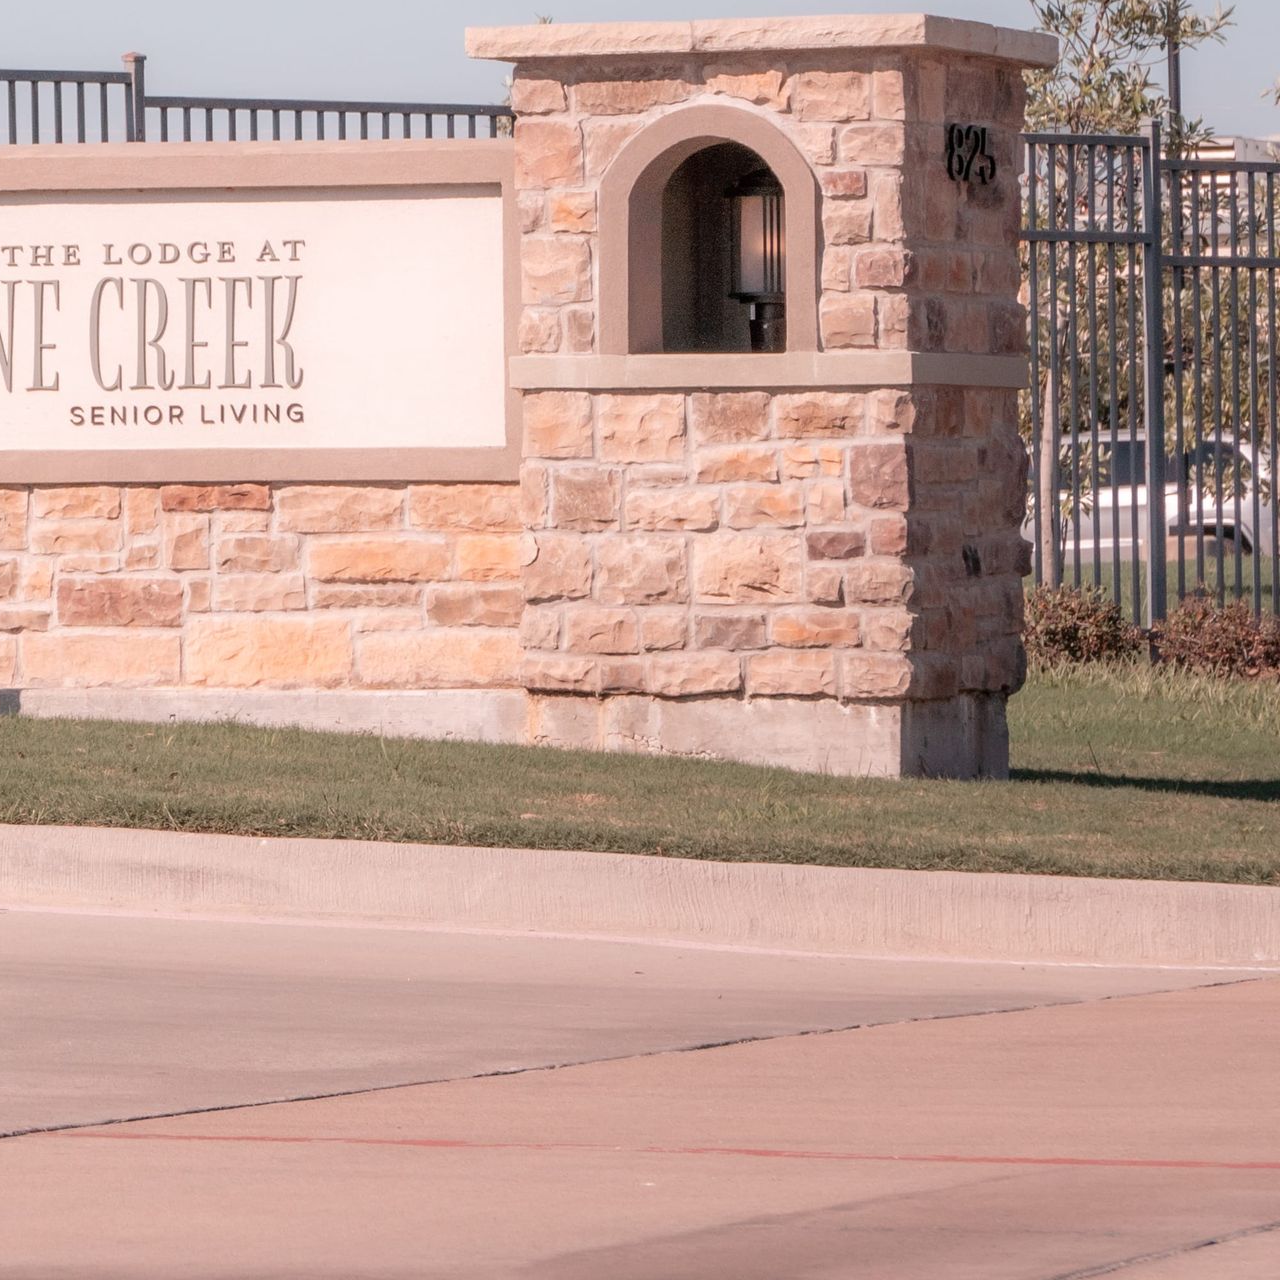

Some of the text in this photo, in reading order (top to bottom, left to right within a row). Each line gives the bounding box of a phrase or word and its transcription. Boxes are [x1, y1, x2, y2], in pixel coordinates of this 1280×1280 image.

[947, 123, 996, 185] 825
[0, 239, 306, 268] THE LODGE AT
[89, 275, 304, 392] CREEK
[69, 402, 305, 427] SENIOR LIVING
